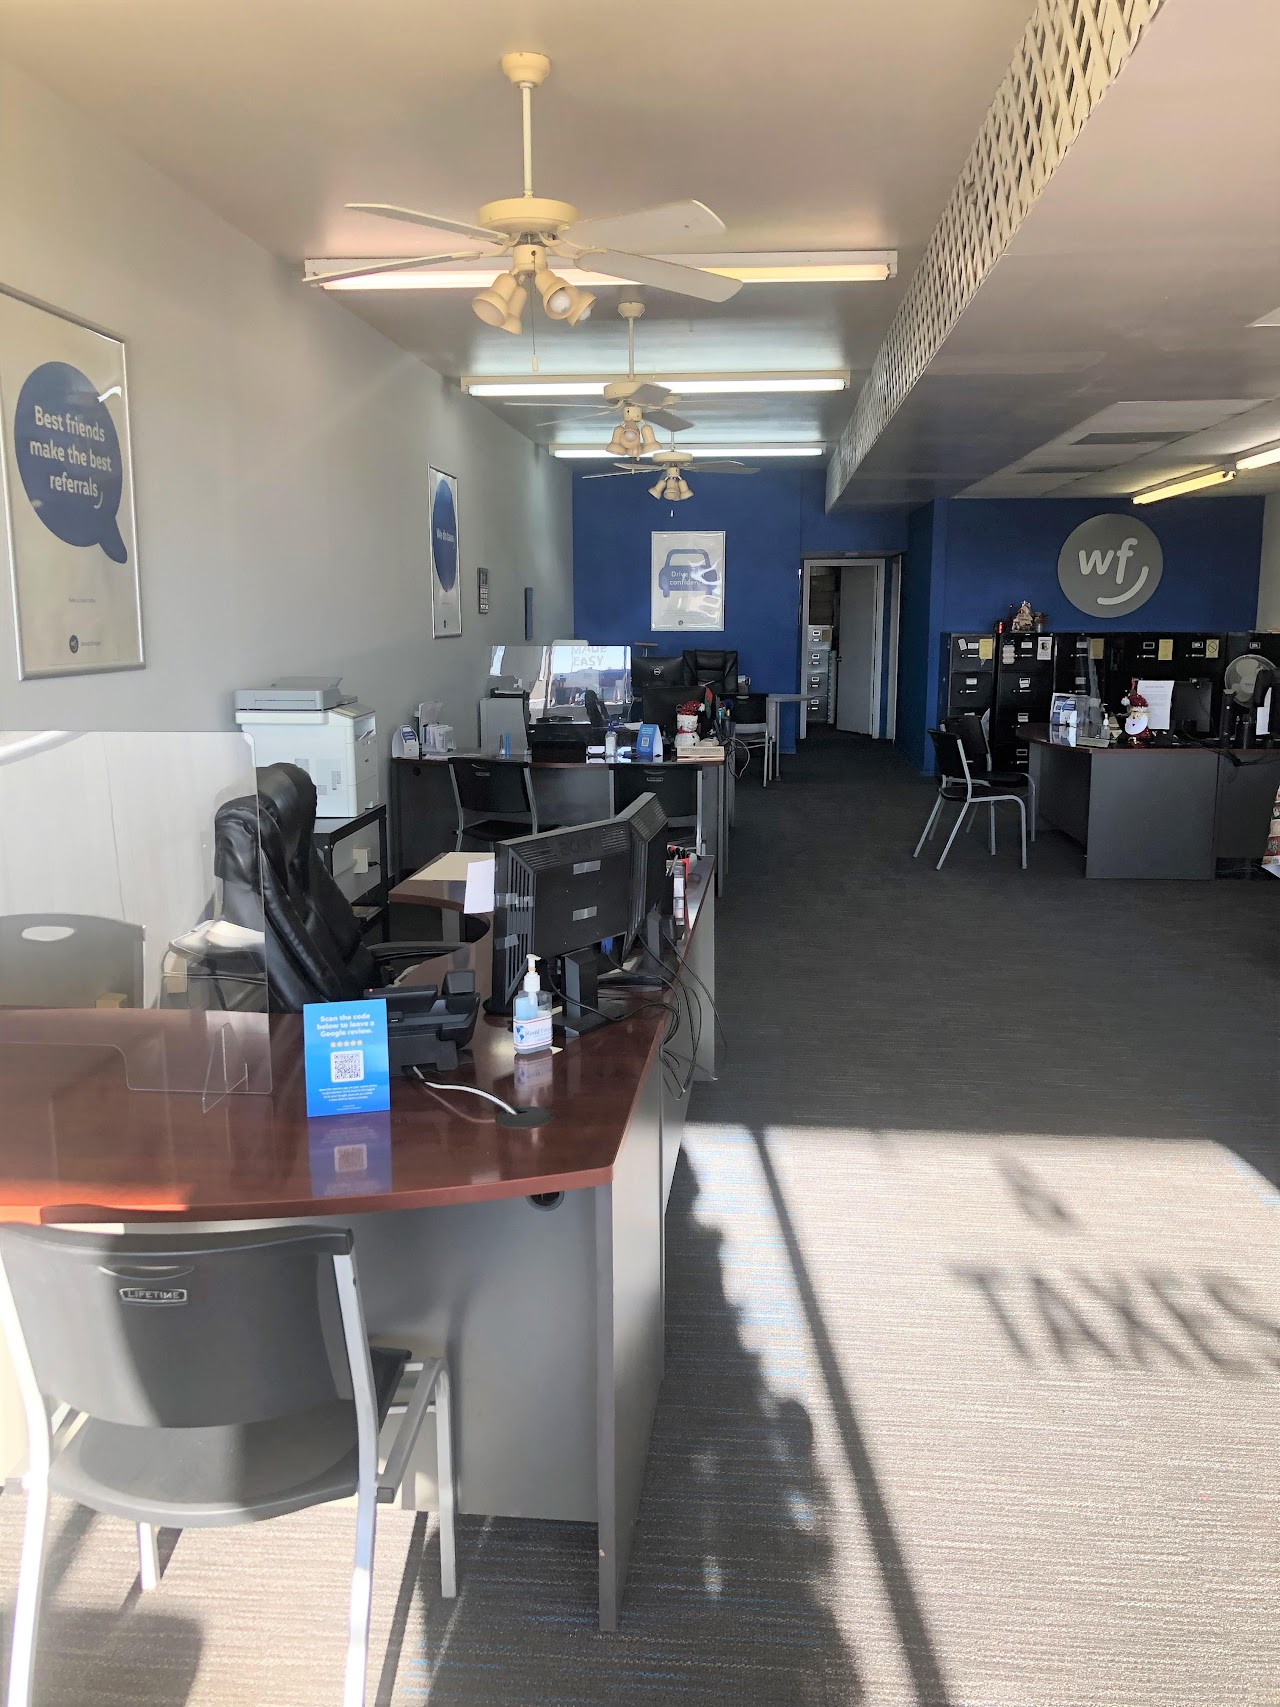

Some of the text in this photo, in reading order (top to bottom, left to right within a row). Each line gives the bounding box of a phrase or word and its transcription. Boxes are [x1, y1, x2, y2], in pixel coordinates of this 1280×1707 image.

[34, 405, 105, 442] Best friends
[30, 439, 112, 472] make the best
[49, 471, 99, 498] referrals
[1079, 538, 1138, 584] wf
[572, 646, 607, 654] MADE
[573, 655, 604, 667] EASY
[352, 1012, 371, 1020] code
[316, 1022, 339, 1030] below
[349, 1020, 369, 1028] leave
[320, 1027, 373, 1038] Google review.
[127, 1290, 180, 1299] LIFETIME
